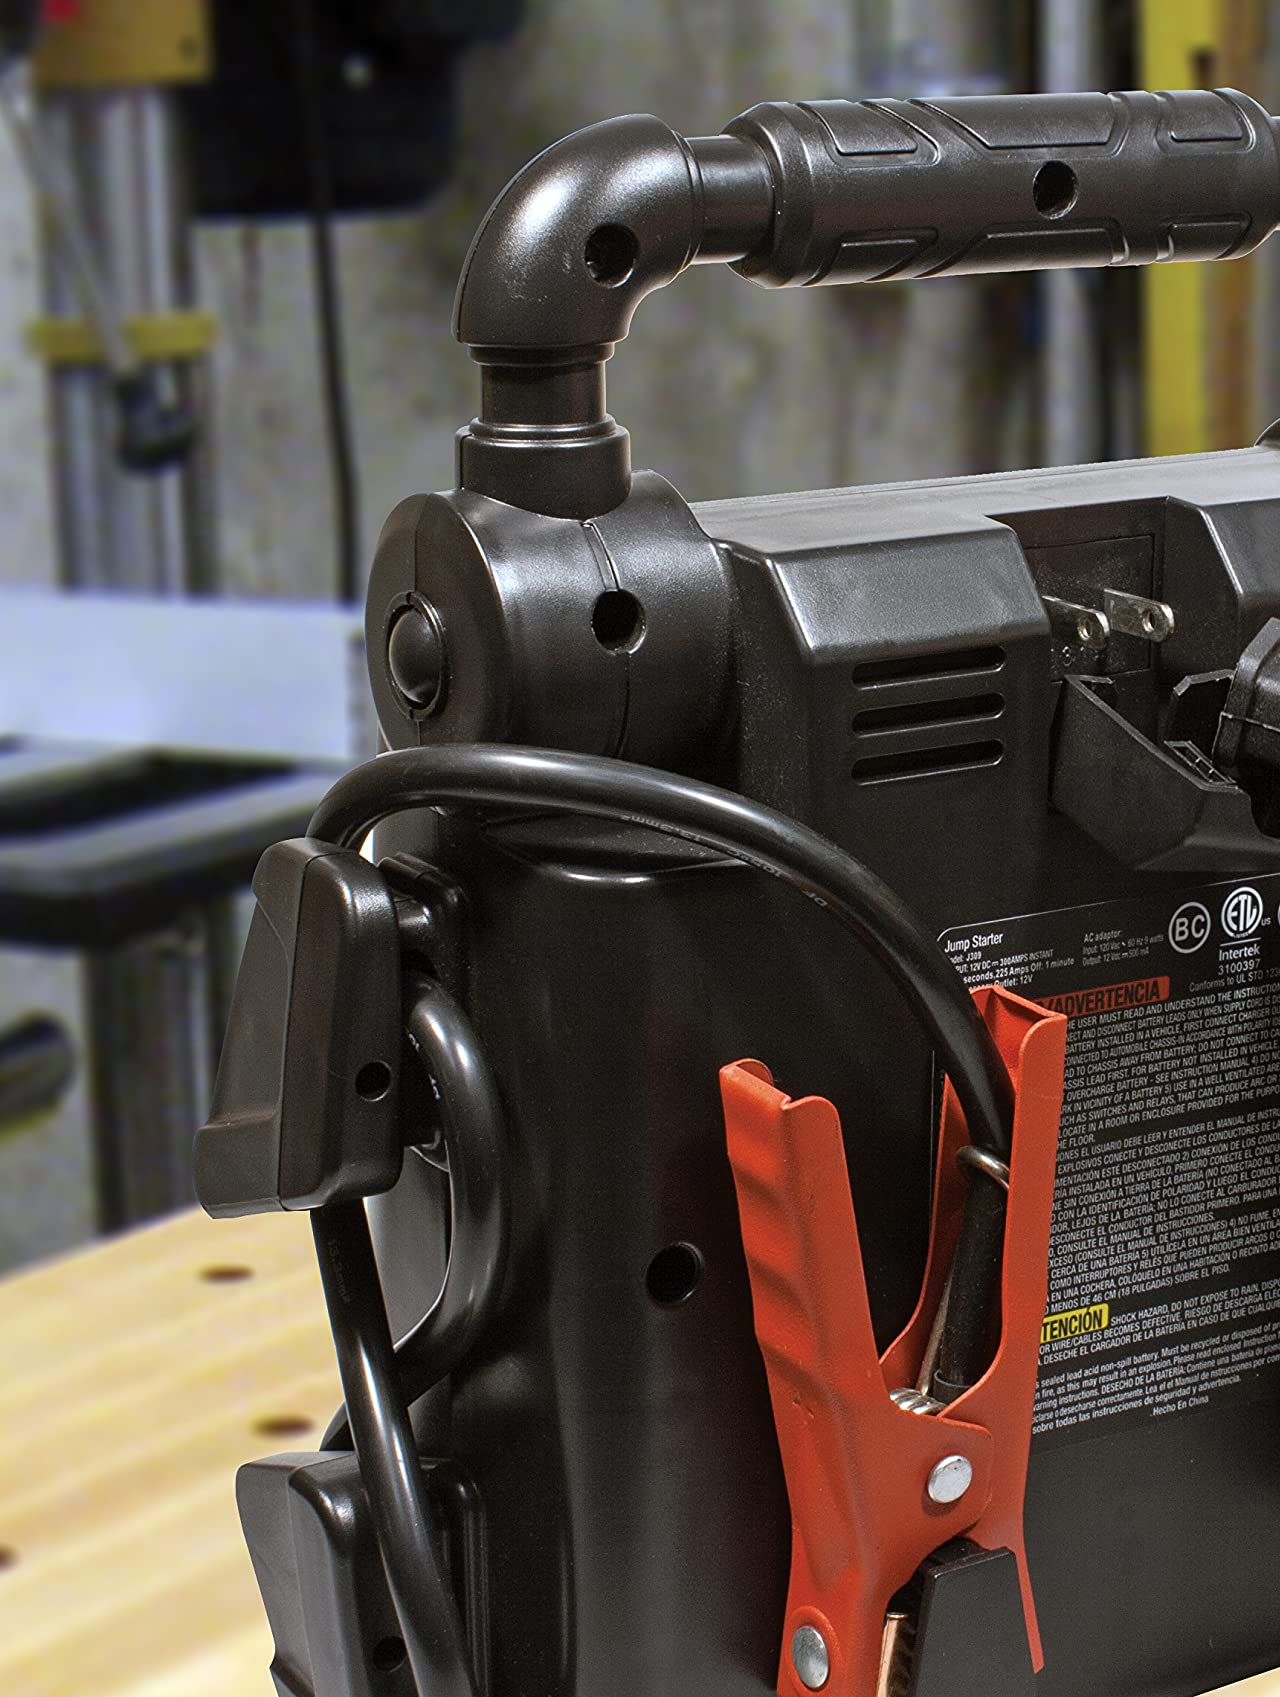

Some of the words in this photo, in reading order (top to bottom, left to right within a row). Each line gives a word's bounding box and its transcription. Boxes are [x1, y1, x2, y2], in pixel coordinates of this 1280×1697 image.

[1227, 894, 1257, 931] ETL
[1261, 917, 1271, 926] US
[1083, 933, 1093, 942] AC
[1175, 914, 1204, 941] BC
[944, 939, 970, 953] Jump
[972, 932, 1004, 949] Starter
[966, 951, 982, 962] J309
[1218, 943, 1260, 961] Intertek
[1009, 962, 1029, 977] Amps
[1050, 956, 1075, 968] minute
[1020, 974, 1033, 985] 12V
[1218, 959, 1260, 974] 3100397
[1189, 977, 1224, 992] Conforms
[1226, 976, 1233, 984] to
[1236, 974, 1245, 982] UL
[1137, 1015, 1164, 1028] BATTERY
[1165, 1011, 1186, 1023] LEADS
[1223, 1001, 1245, 1012] SUPPLY
[1145, 1004, 1162, 1014] AND
[1217, 992, 1231, 1001] THE
[1065, 1040, 1095, 1053] BATTERY
[1097, 1033, 1134, 1047] INSTALLED
[1204, 1014, 1236, 1027] CONNECT
[1185, 1027, 1225, 1042] ACCORDANCE
[1227, 1024, 1242, 1035] WITH
[1086, 1074, 1105, 1084] LEAD
[1148, 1059, 1180, 1072] BATTERY
[1199, 1048, 1238, 1062] INSTALLED
[1087, 1059, 1118, 1073] CHASSIS
[1119, 1055, 1139, 1066] AWAY
[1140, 1050, 1161, 1062] FROM
[1067, 1083, 1114, 1100] OVERCHARGE
[1116, 1076, 1148, 1090] BATTERY
[1155, 1072, 1169, 1083] SEE
[1082, 1096, 1112, 1109] VICINITY
[1131, 1085, 1163, 1099] BATTERY
[1204, 1074, 1223, 1085] WELL
[1128, 1101, 1144, 1111] AND
[1178, 1091, 1195, 1101] THAT
[1197, 1087, 1213, 1097] CAN
[1058, 1124, 1086, 1137] LOCATE
[1105, 1115, 1127, 1127] ROOM
[1141, 1104, 1185, 1120] ENCLOSURE
[1143, 1132, 1161, 1143] LEER
[1168, 1123, 1205, 1138] ENTENDER
[1216, 1115, 1244, 1128] MANUAL
[1103, 1149, 1136, 1164] CONECTE
[1144, 1138, 1191, 1155] DESCONECTE
[1192, 1135, 1206, 1145] LOS
[1121, 1153, 1180, 1172] DESCONECTADO
[1191, 1141, 1228, 1158] CONEXIÓN
[1241, 1137, 1256, 1148] LOS
[1068, 1179, 1110, 1195] INSTALADA
[1174, 1158, 1208, 1172] PRIMERO
[1209, 1151, 1242, 1165] CONECTE
[1057, 1209, 1074, 1220] CON
[1088, 1192, 1148, 1214] IDENTIFICACIÓN
[1162, 1180, 1205, 1197] POLARIDAD
[1063, 1197, 1076, 1208] SIN
[1078, 1188, 1116, 1205] CONEXIÓN
[1124, 1181, 1150, 1195] TIERRA
[1071, 1216, 1096, 1229] LEJOS
[1180, 1189, 1214, 1204] CONECTE
[1227, 1176, 1276, 1194] CARBURADOR
[1107, 1215, 1152, 1233] CONDUCTOR
[1154, 1211, 1167, 1222] DEL
[1242, 1190, 1261, 1202] PARA
[1051, 1265, 1076, 1278] CERCA
[1090, 1258, 1107, 1269] UNA
[1233, 1225, 1250, 1237] BIEN
[1057, 1238, 1096, 1254] CONSULTE
[1109, 1229, 1140, 1243] MANUAL
[1127, 1236, 1156, 1250] MANUAL
[1049, 1277, 1072, 1289] COMO
[1073, 1263, 1132, 1284] INTERRUPTORES
[1163, 1253, 1177, 1263] QUE
[1063, 1287, 1078, 1298] UNA
[1117, 1267, 1160, 1285] COLÓQUELO
[1189, 1250, 1230, 1269] HABITACIÓN
[1050, 1299, 1078, 1312] MENOS
[1174, 1270, 1199, 1283] SOBRE
[1103, 1322, 1140, 1338] BECOMES
[1224, 1293, 1262, 1309] DESCARGA
[1110, 1312, 1136, 1325] SHOCK
[1183, 1297, 1198, 1308] NOT
[1200, 1290, 1228, 1304] EXPOSE
[1042, 1306, 1102, 1341] TENCIÓN
[1043, 1348, 1077, 1364] DESECHE
[1090, 1335, 1130, 1352] CARGADOR
[1198, 1314, 1218, 1325] CASO
